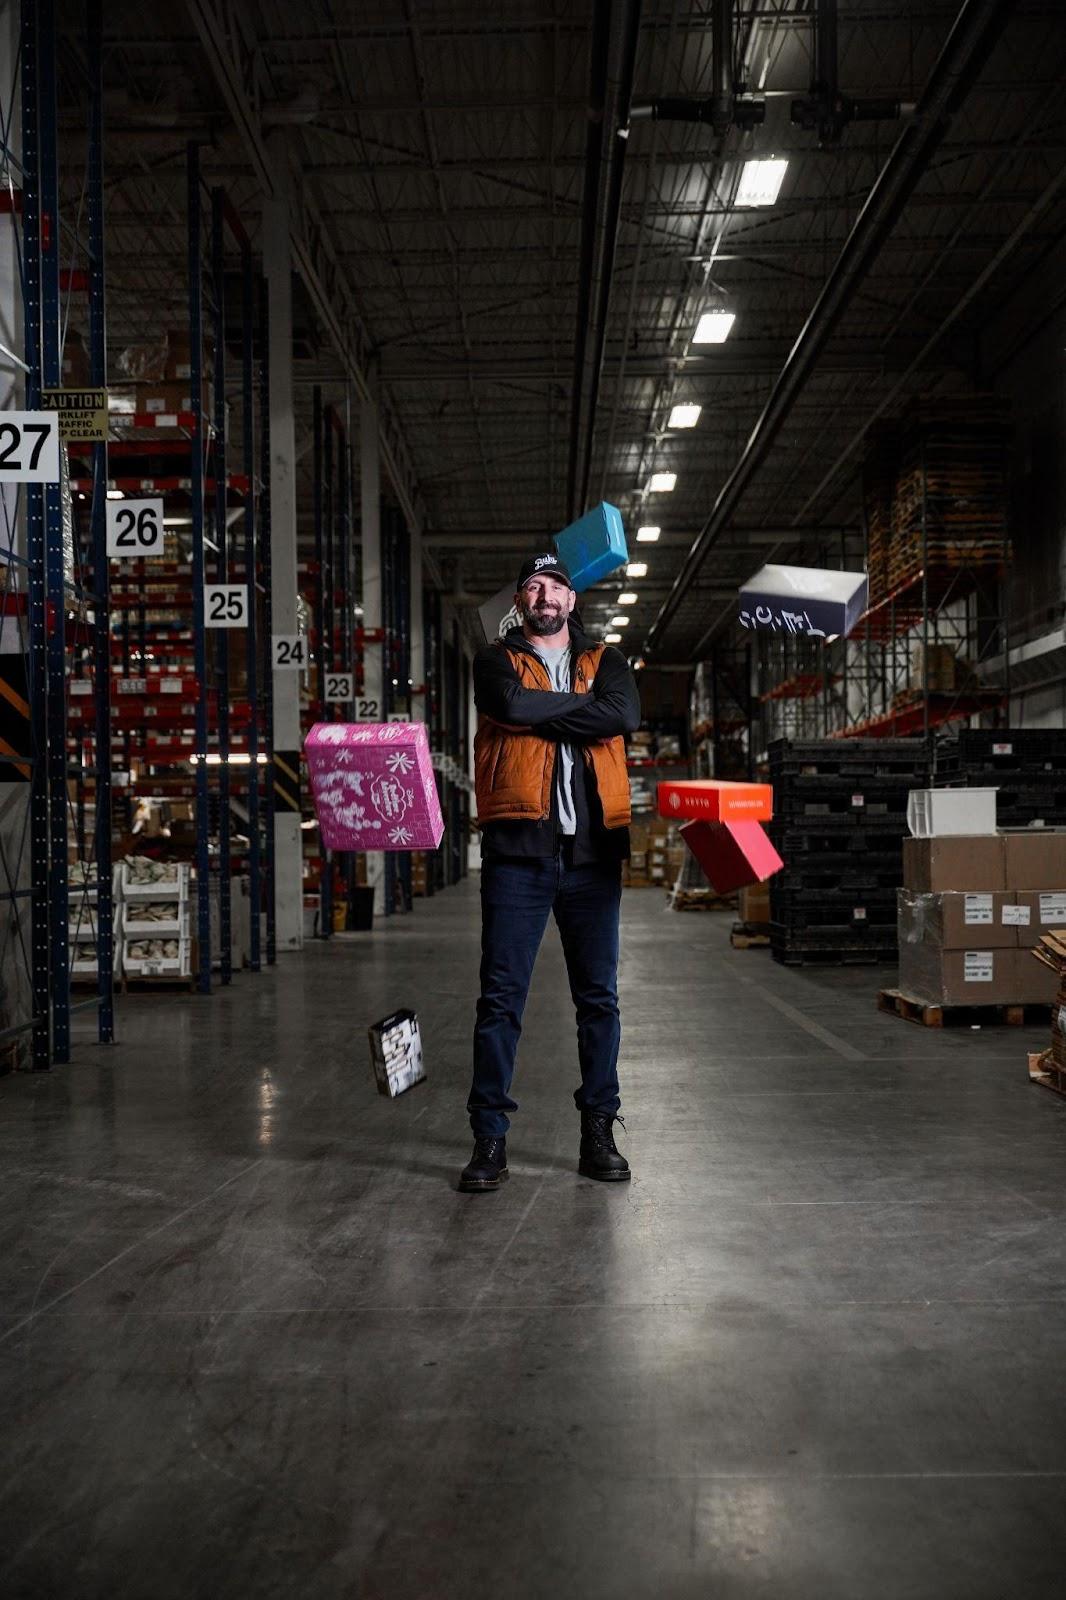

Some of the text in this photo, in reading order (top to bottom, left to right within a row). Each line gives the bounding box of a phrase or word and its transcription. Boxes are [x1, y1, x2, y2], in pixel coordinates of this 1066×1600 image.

[42, 394, 103, 408] CAUTION
[58, 420, 93, 428] RAFFIC
[70, 429, 103, 437] CLEAR
[0, 423, 51, 470] 27
[115, 508, 158, 547] 26
[210, 591, 243, 620] 25
[277, 641, 303, 664] 24
[328, 678, 349, 697] 23
[359, 701, 378, 717] 22
